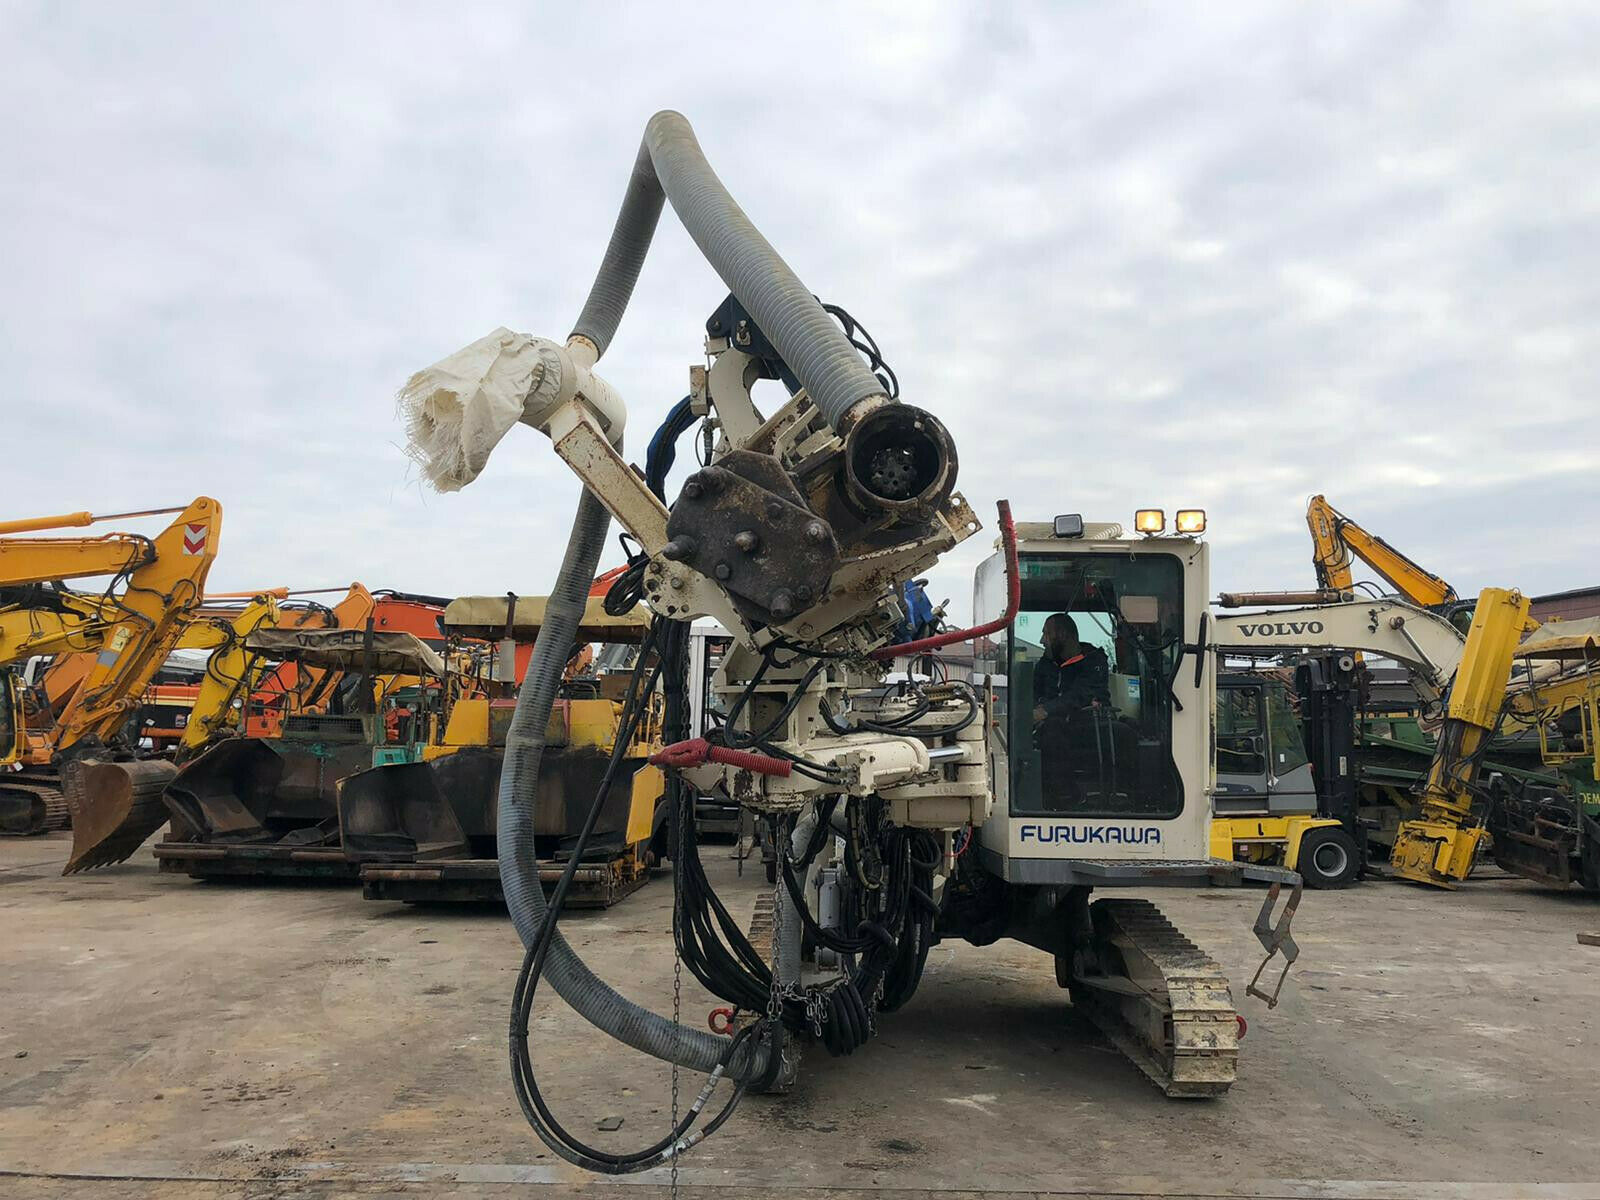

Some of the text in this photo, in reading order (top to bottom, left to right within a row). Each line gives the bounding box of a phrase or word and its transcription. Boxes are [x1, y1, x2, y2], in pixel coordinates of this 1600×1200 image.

[1237, 621, 1324, 637] VOLVO
[296, 630, 366, 647] VOGEL
[1020, 825, 1161, 844] FURUKAWA
